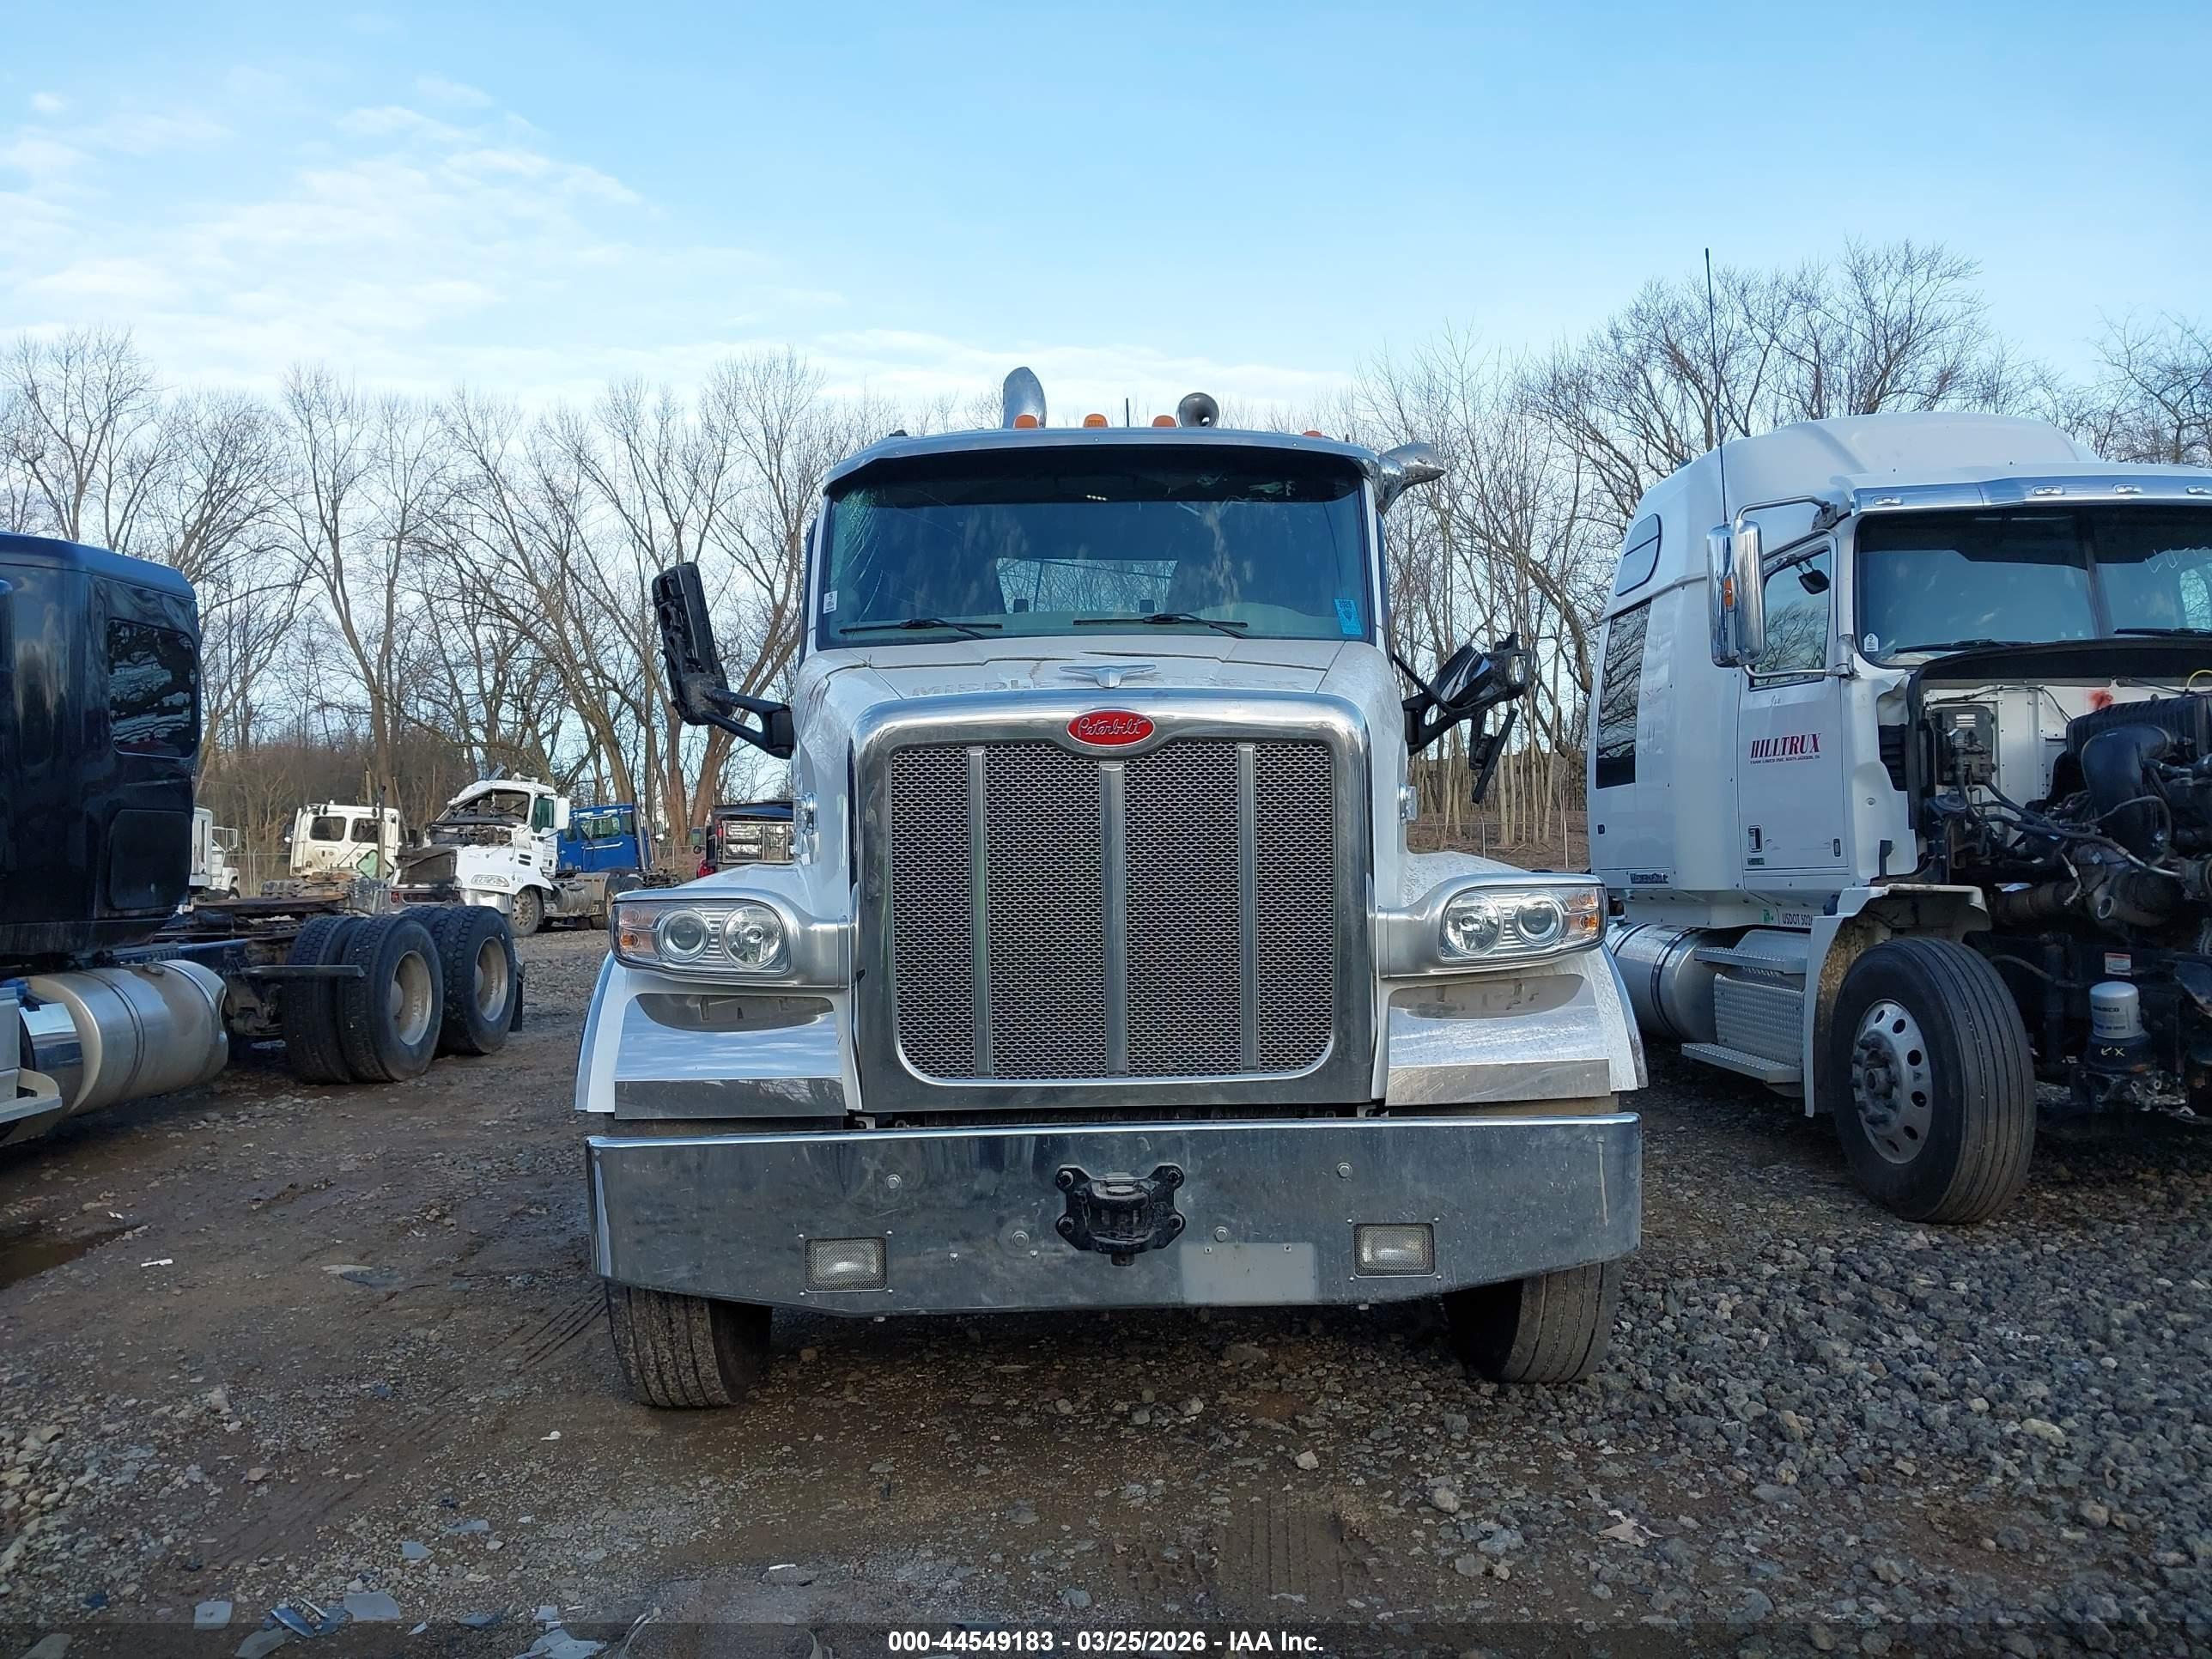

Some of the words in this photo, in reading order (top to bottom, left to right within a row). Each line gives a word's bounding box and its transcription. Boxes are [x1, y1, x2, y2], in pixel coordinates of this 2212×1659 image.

[1078, 717, 1147, 738] Peterbilt
[1750, 732, 1821, 759] HILLTRUX
[1781, 913, 1800, 926] USDOT
